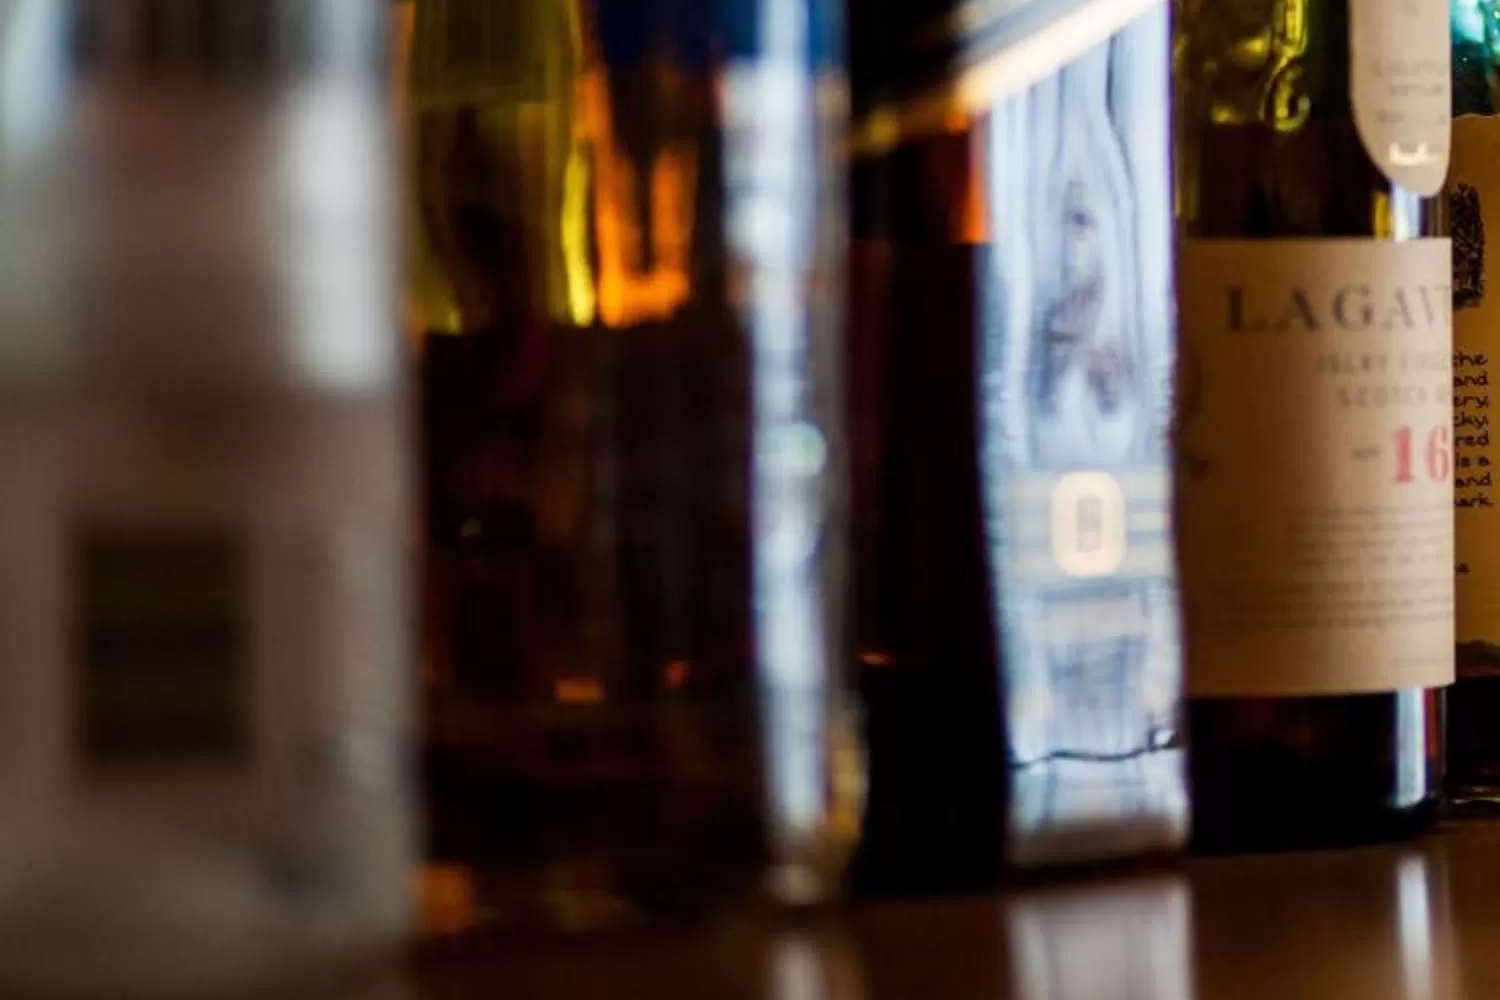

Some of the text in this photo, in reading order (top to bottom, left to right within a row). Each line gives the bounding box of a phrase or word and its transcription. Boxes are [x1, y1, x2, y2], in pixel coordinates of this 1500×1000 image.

[1453, 371, 1488, 388] and
[1394, 425, 1449, 485] 16
[1454, 471, 1492, 488] and
